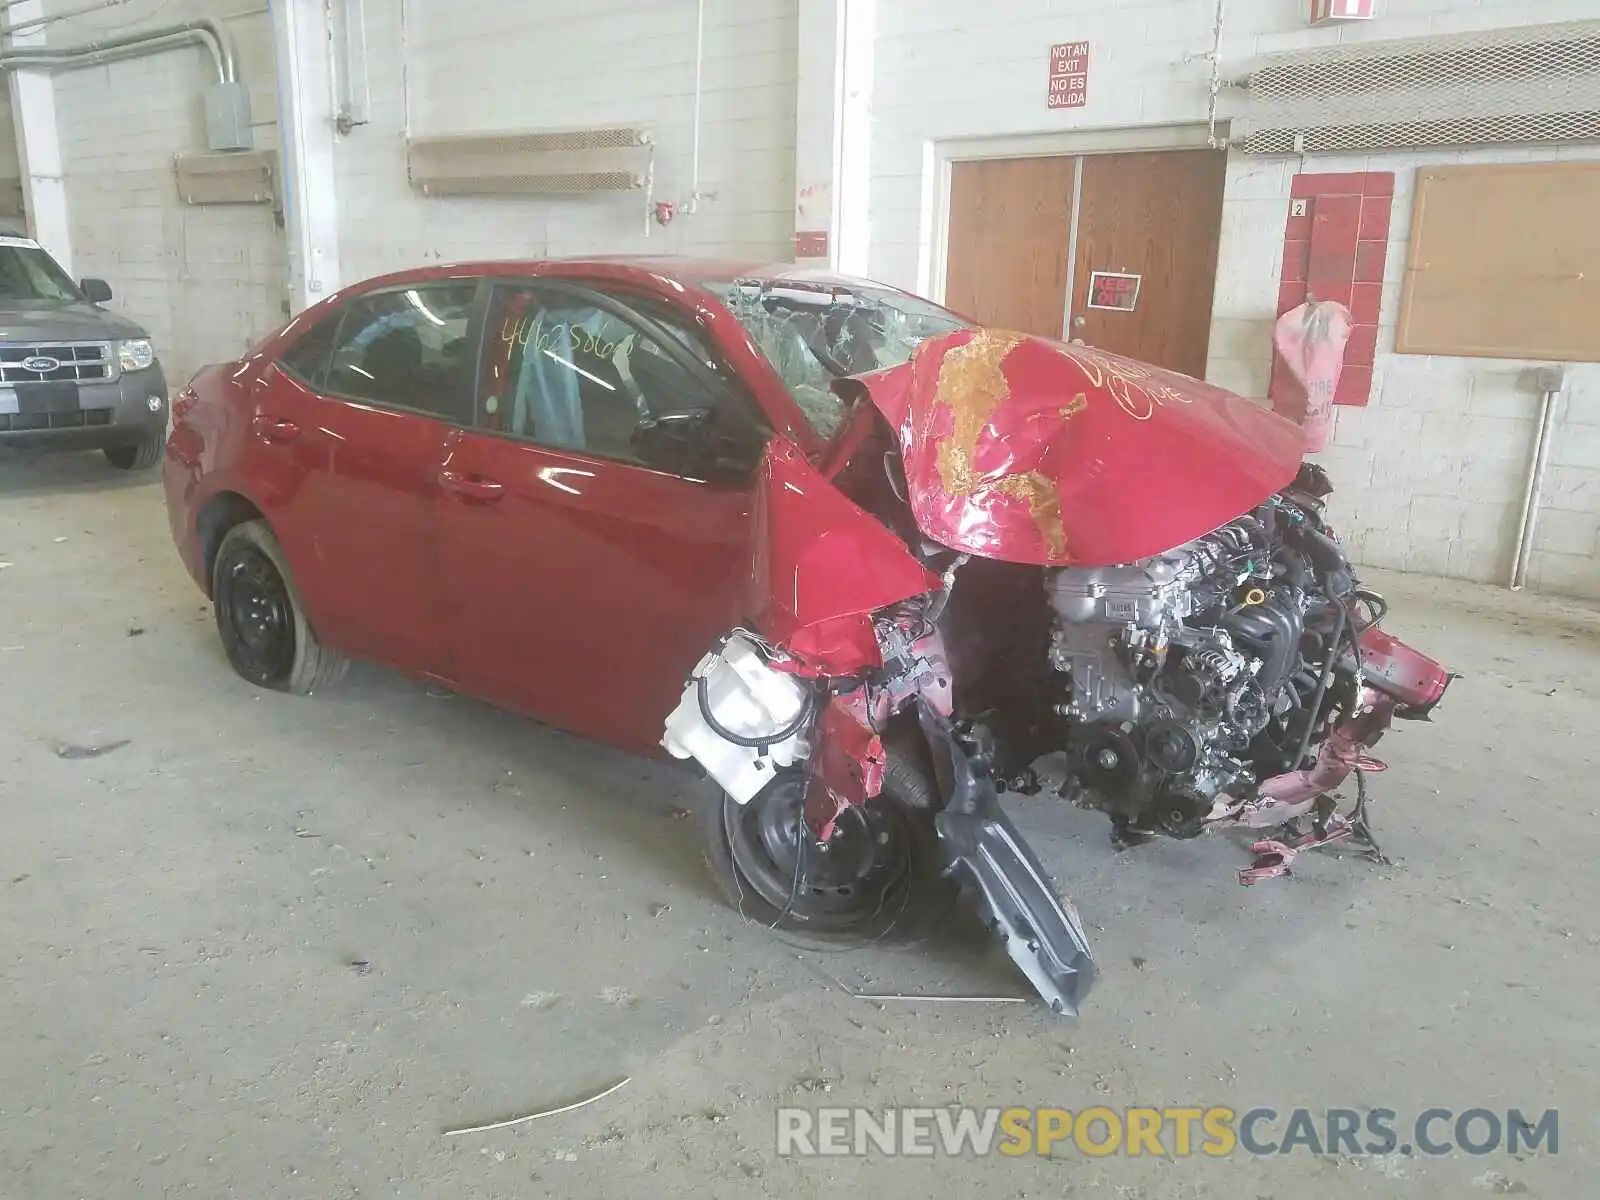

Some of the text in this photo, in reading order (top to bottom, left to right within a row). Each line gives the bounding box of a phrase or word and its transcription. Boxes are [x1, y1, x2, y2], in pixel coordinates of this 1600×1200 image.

[1052, 43, 1087, 58] NOT AN
[1058, 60, 1080, 72] EXIT
[1051, 78, 1085, 91] NO ES
[1048, 93, 1085, 105] SALIDA
[1296, 204, 1302, 215] 2
[1095, 278, 1136, 291] KEEP
